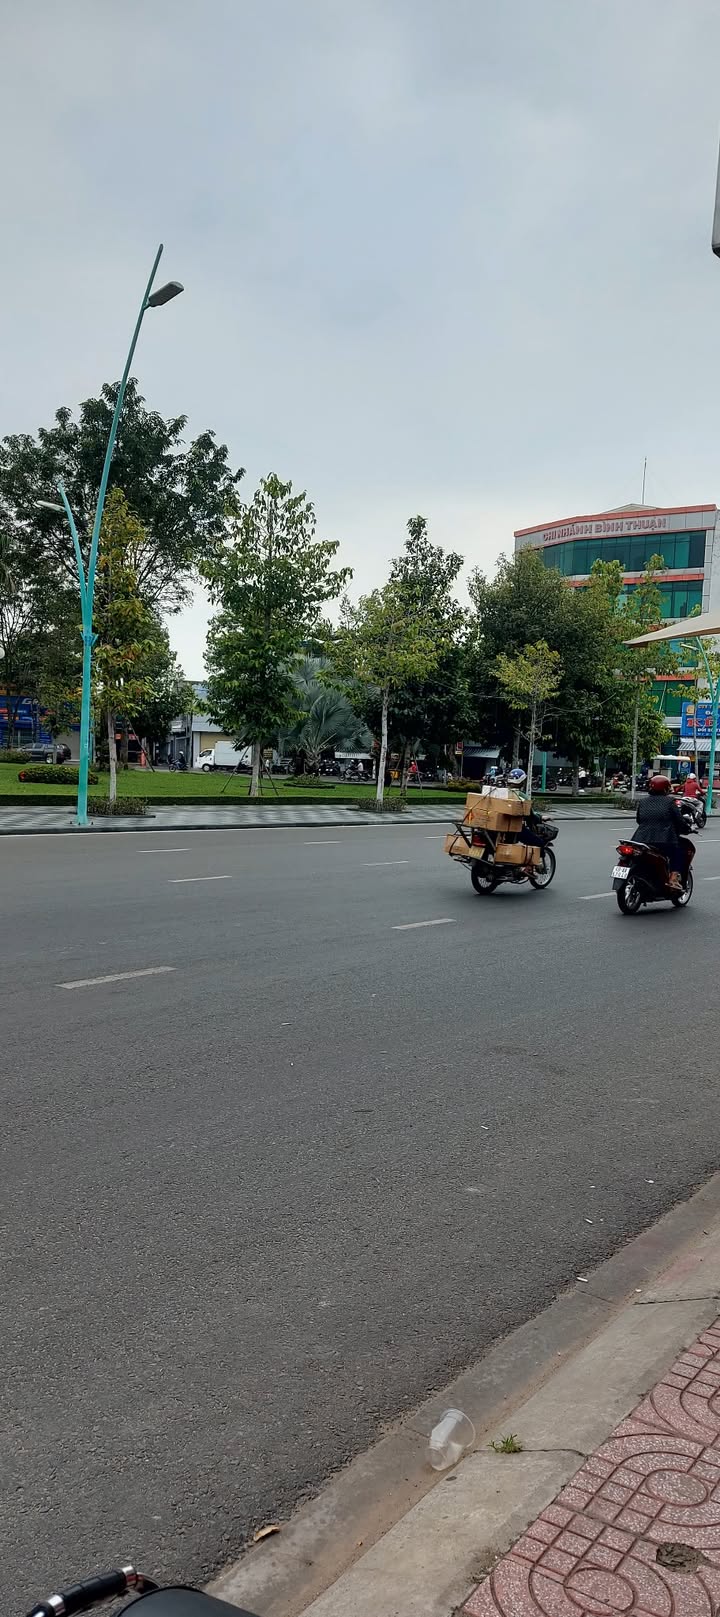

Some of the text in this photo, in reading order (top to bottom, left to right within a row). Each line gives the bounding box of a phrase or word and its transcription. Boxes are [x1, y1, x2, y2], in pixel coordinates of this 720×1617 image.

[543, 517, 667, 542] CHI NHÁNH BÌNH THUẬN
